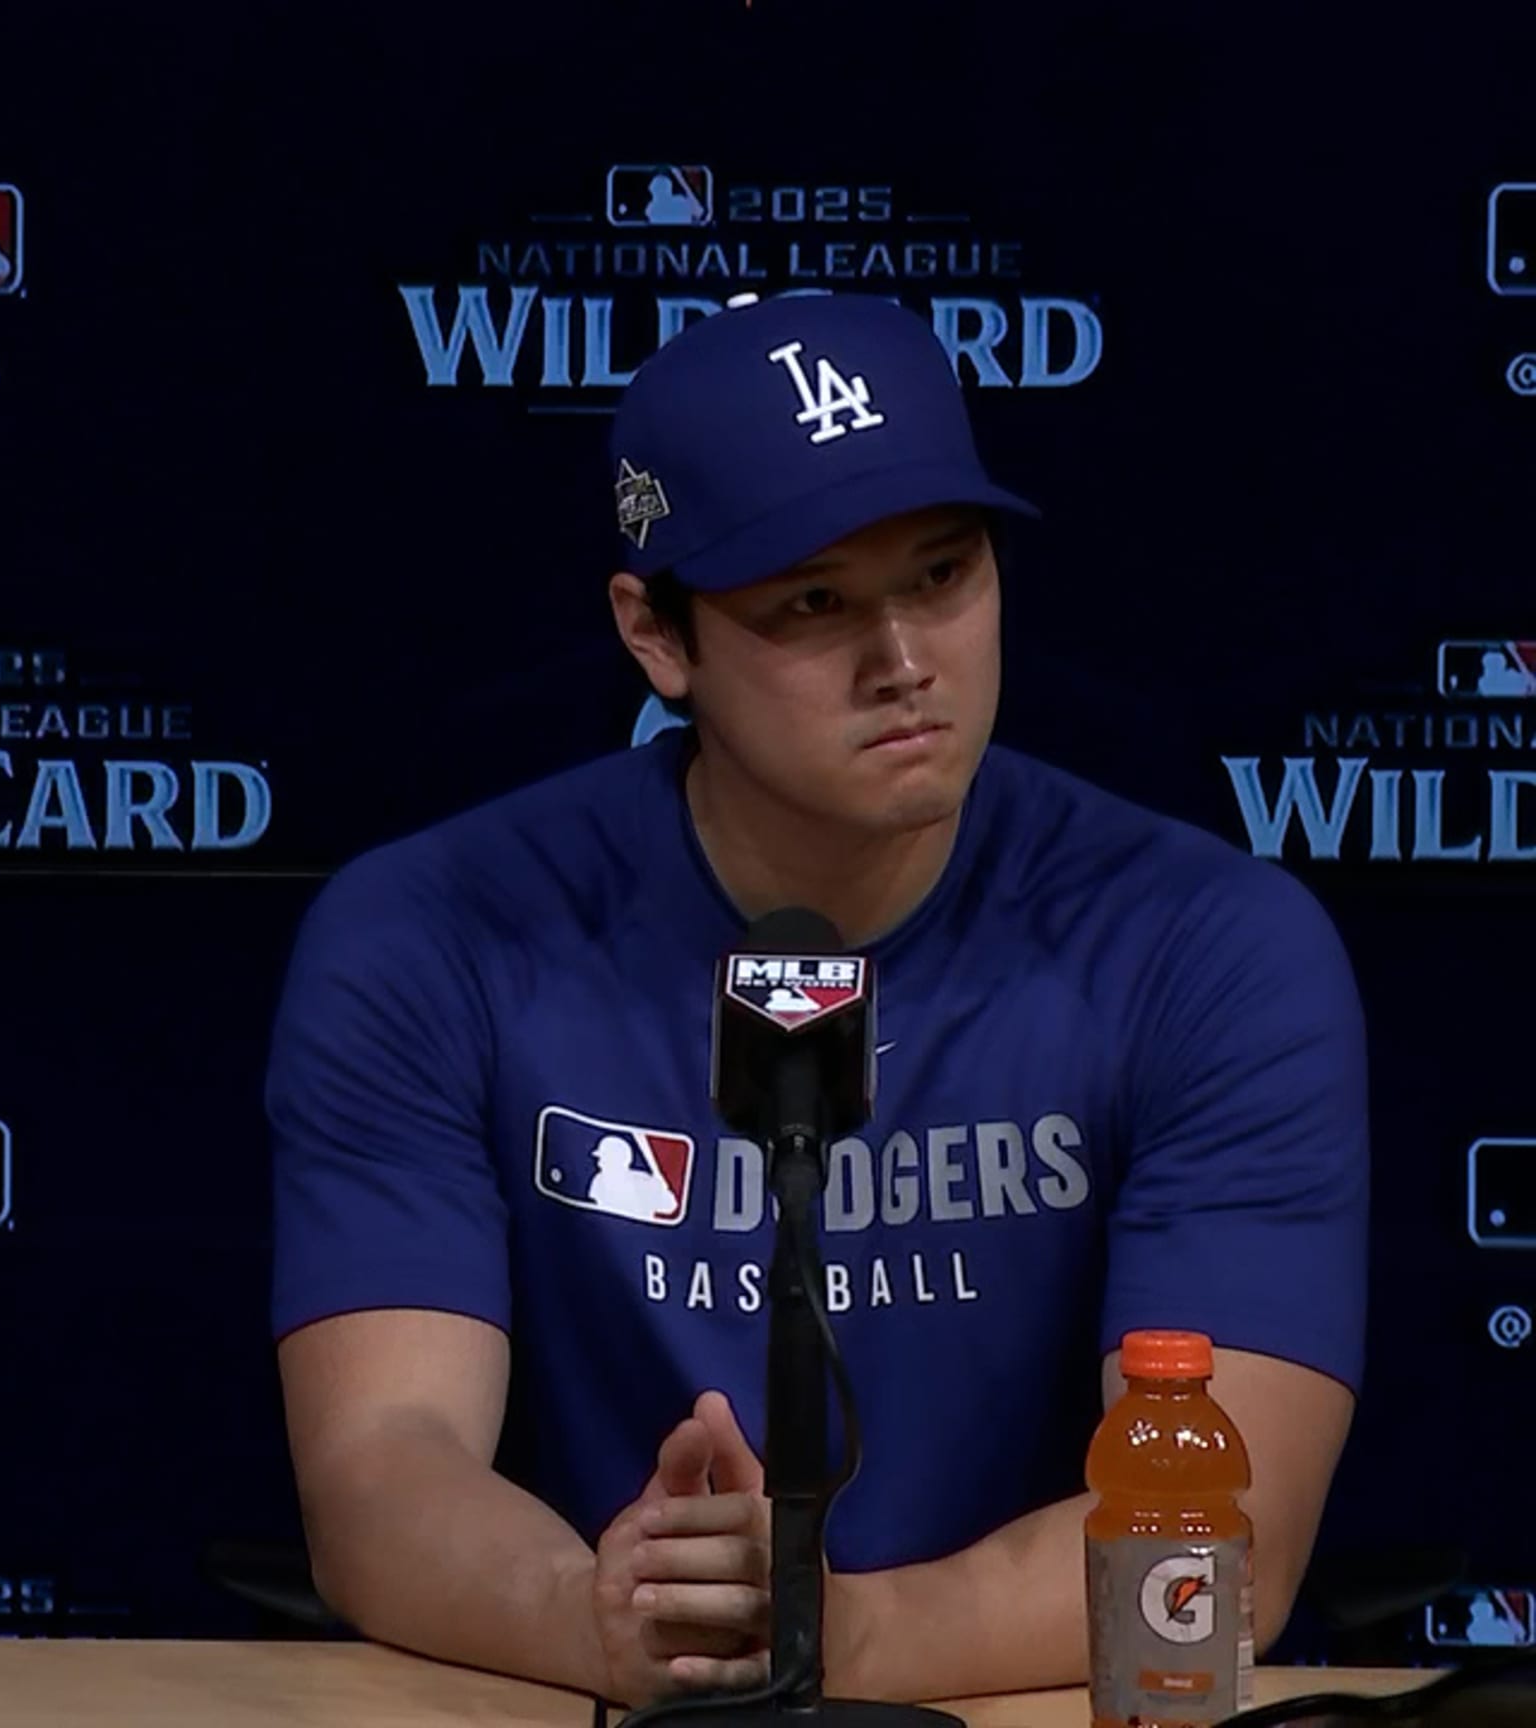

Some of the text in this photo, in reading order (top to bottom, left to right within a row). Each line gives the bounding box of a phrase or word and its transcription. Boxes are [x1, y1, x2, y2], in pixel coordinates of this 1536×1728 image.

[727, 185, 893, 223] 2025
[475, 241, 1024, 277] NATIONAL LEAGUE
[397, 283, 724, 388] WIL
[767, 339, 885, 445] LA
[1302, 711, 1536, 750] NATION
[736, 960, 857, 981] MLB
[712, 1113, 1090, 1232] DDGERS
[644, 1250, 979, 1313] BASBALL
[1138, 1553, 1215, 1645] G
